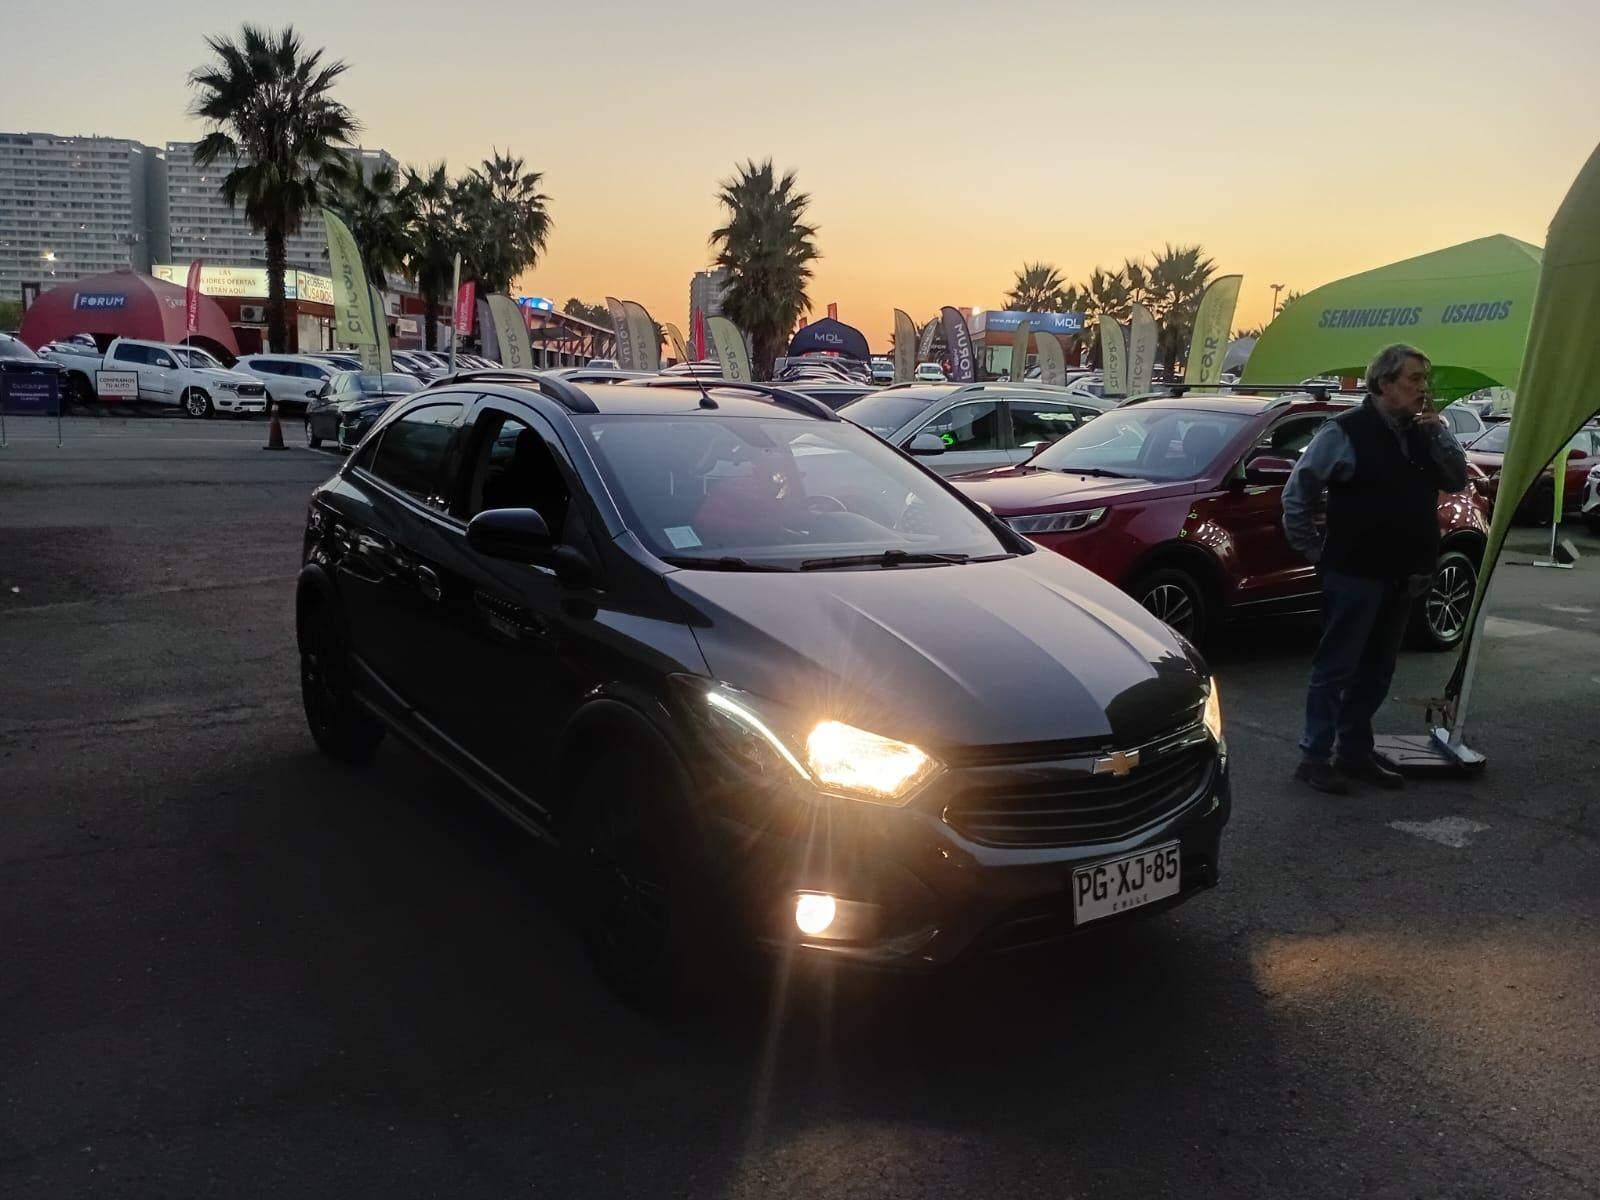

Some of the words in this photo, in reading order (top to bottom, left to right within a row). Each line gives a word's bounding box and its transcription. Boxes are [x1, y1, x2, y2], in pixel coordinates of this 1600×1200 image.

[80, 297, 125, 306] FORUM
[1318, 307, 1423, 329] SEMINUEVOS
[1441, 300, 1513, 325] USADOS
